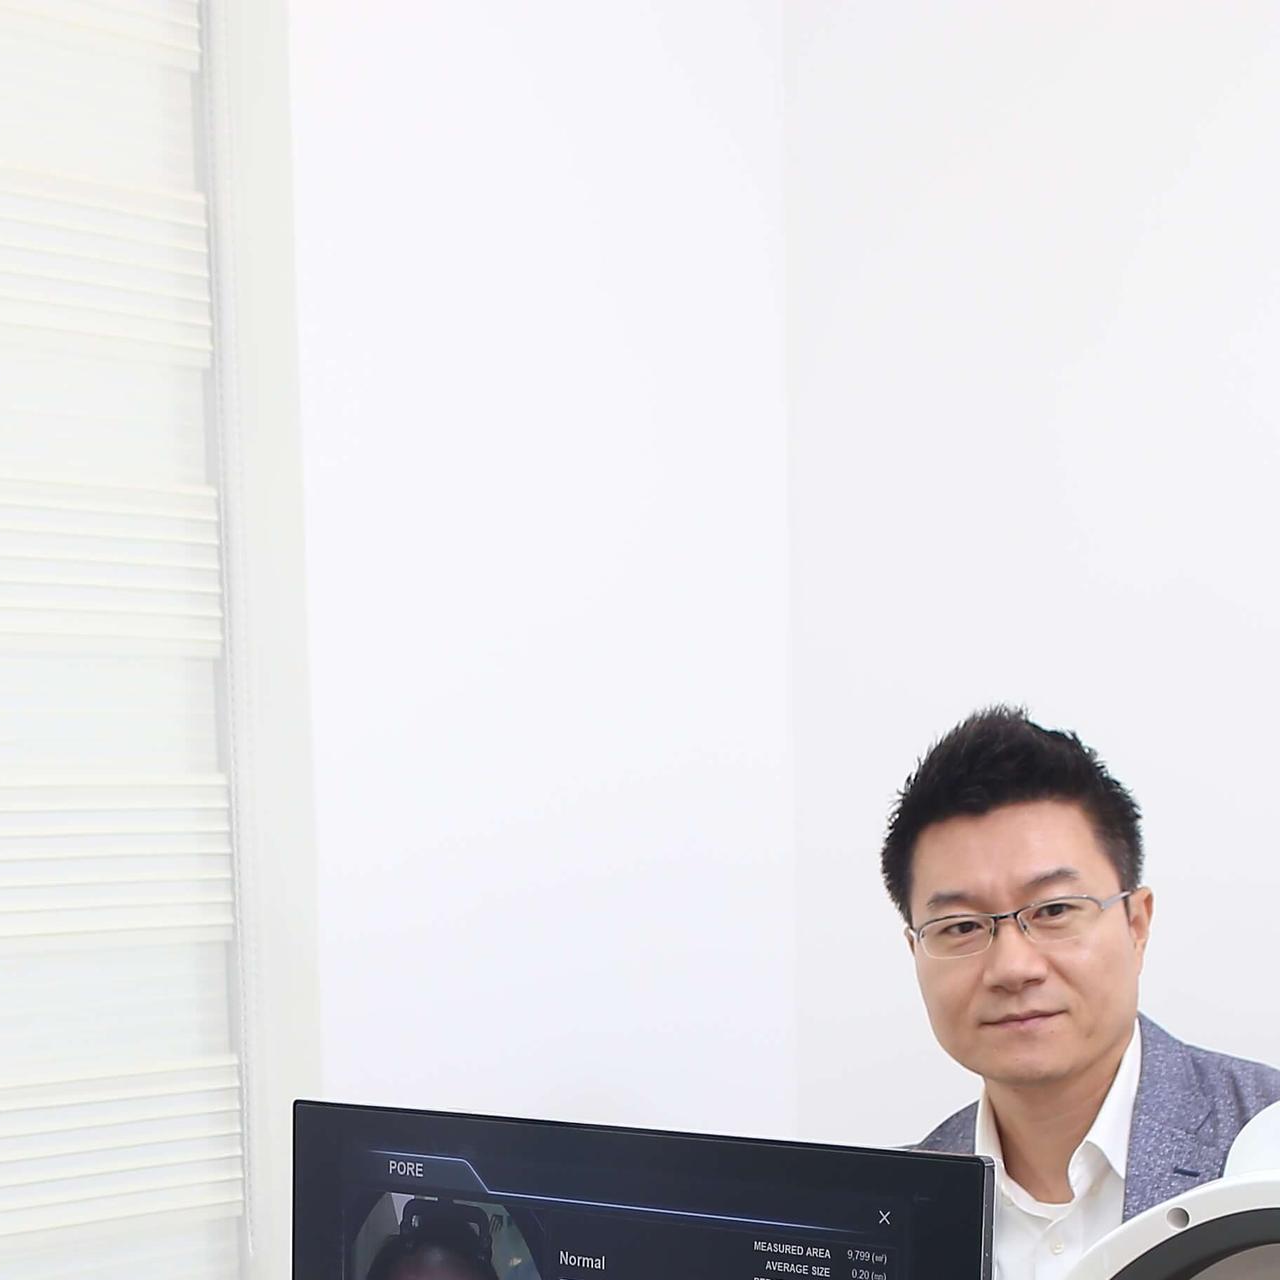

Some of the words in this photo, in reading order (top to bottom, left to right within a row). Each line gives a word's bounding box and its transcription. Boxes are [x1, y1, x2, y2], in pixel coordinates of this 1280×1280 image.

[389, 1160, 424, 1177] PORE
[754, 1241, 804, 1256] MEASURED
[806, 1248, 831, 1260] AREA
[560, 1250, 606, 1270] Normal
[766, 1261, 809, 1275] AVERAGE
[811, 1266, 831, 1278] SIZE
[851, 1268, 870, 1280] 0.20
